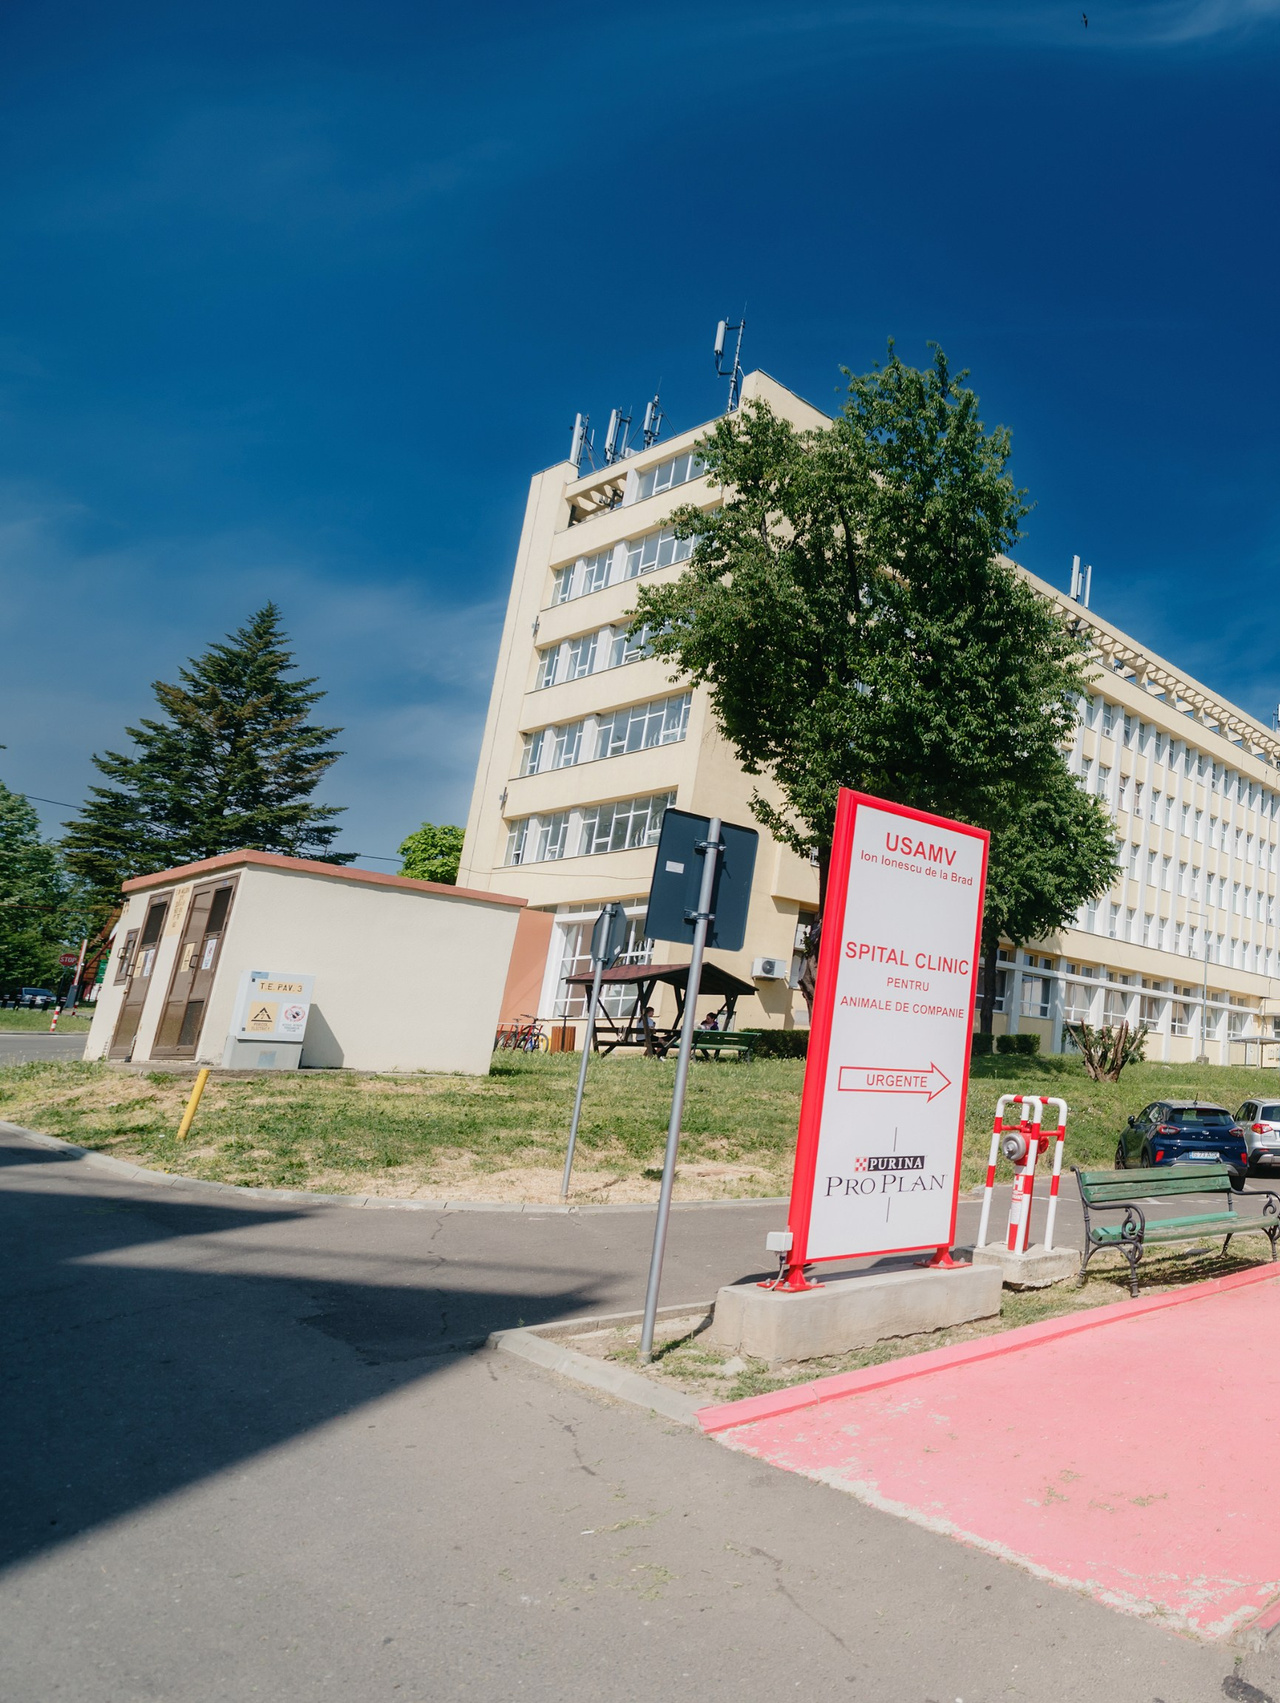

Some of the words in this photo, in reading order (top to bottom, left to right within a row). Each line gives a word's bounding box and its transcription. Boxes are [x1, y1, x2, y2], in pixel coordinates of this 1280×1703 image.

[885, 832, 957, 866] USAMV
[860, 850, 878, 863] Ion
[881, 855, 922, 874] Ionescu
[924, 866, 937, 877] de
[939, 869, 948, 880] la
[950, 872, 973, 886] Brad
[845, 941, 909, 967] SPITAL
[915, 952, 969, 975] CLINIC
[297, 985, 303, 993] 3
[886, 977, 930, 992] PENTRU
[840, 995, 892, 1011] ANIMALE
[895, 1001, 910, 1013] DE
[912, 1004, 965, 1019] COMPANIE
[866, 1073, 928, 1088] URGENTE
[868, 1157, 923, 1170] PURINA
